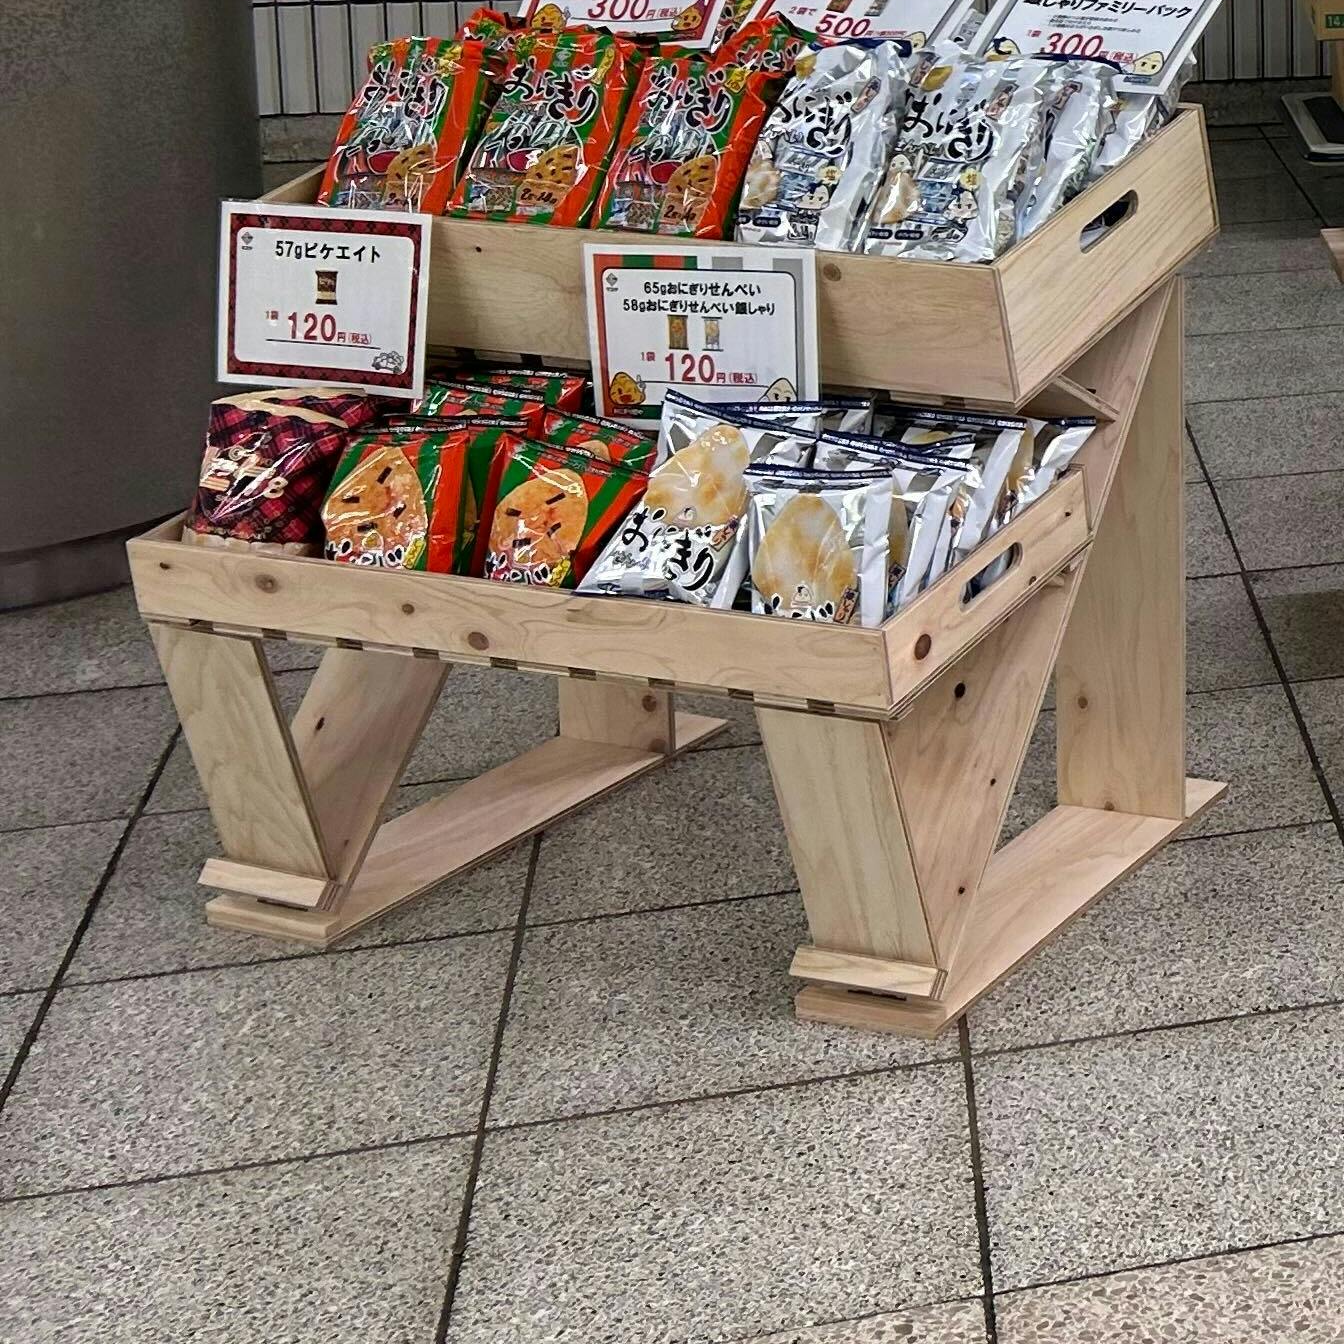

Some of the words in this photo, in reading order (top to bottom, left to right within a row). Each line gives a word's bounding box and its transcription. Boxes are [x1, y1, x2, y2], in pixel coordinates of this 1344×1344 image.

[363, 58, 450, 121] おにぎり
[502, 55, 599, 128] おにぎり
[647, 63, 735, 135] おにぎり
[901, 87, 995, 163] おにぎり
[623, 299, 776, 316] 58gおにぎりせんべい銀しゃり
[644, 281, 761, 296] 65gおにぎりせんべい
[620, 507, 717, 592] おにぎり
